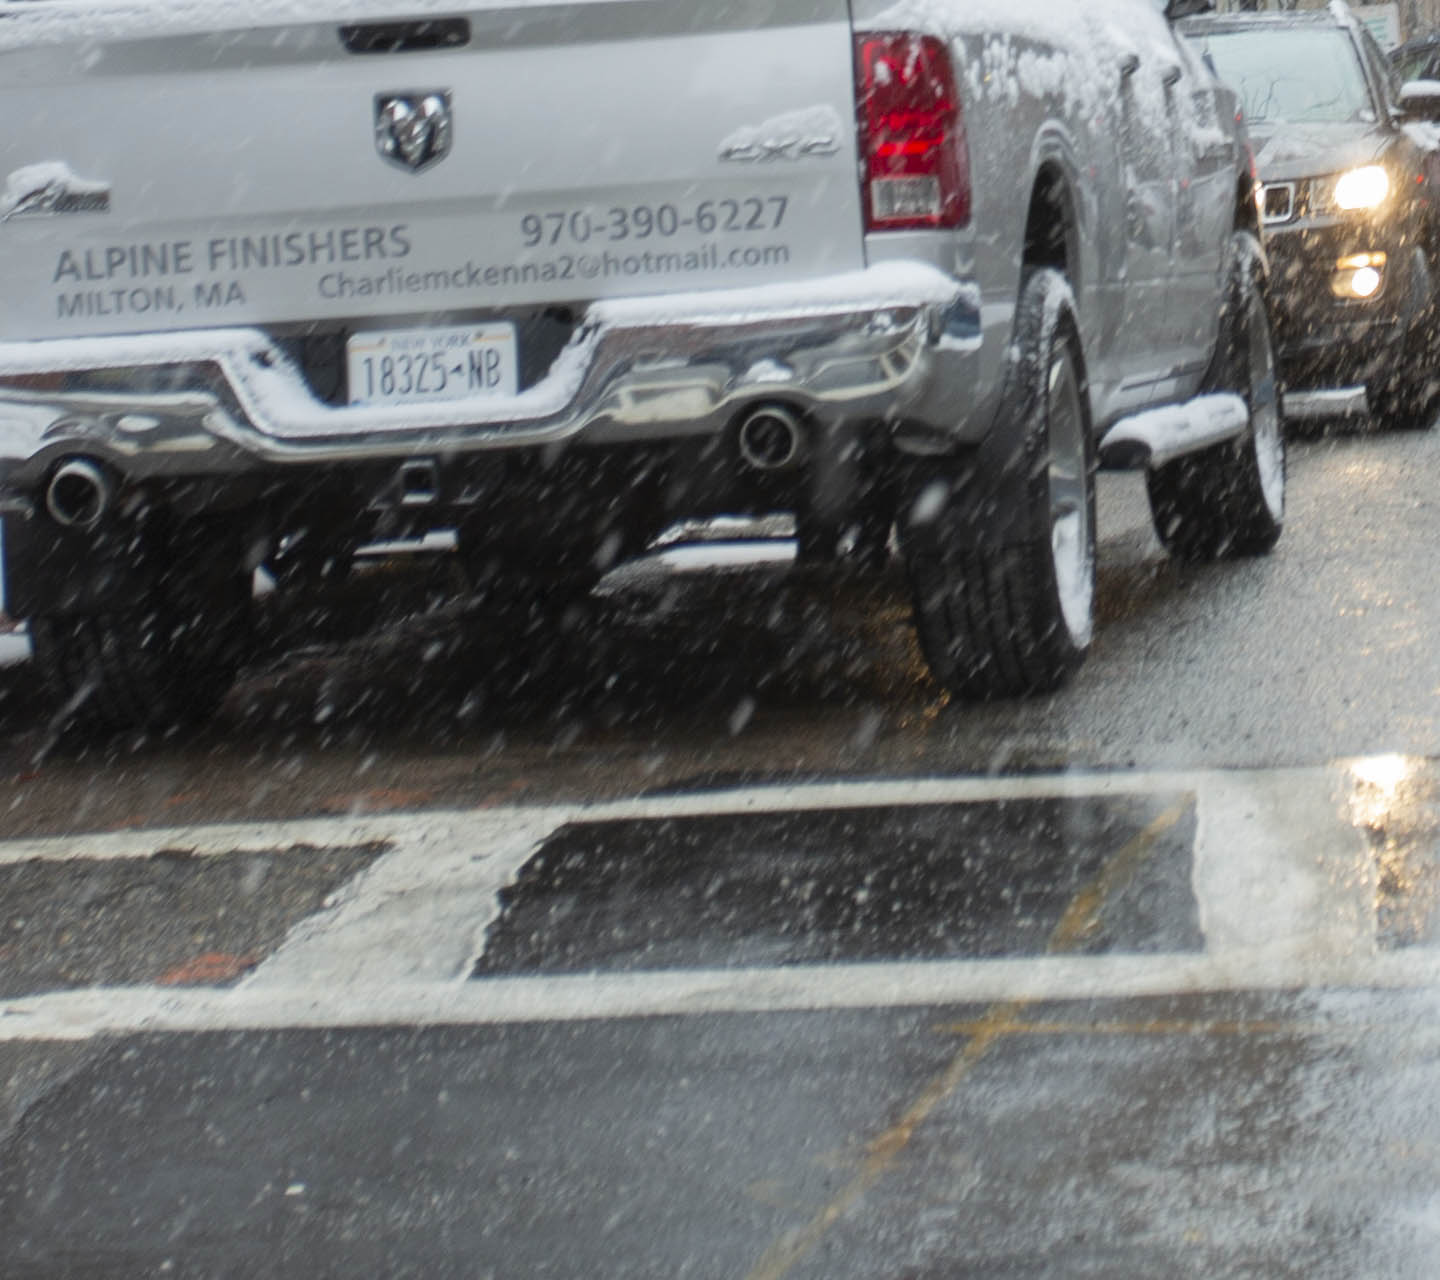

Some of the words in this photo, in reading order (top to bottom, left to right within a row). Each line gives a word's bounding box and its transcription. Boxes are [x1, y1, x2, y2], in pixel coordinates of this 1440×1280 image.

[521, 196, 790, 248] 970-390-6227
[53, 241, 193, 282] ALPINE
[208, 224, 412, 272] FINISHERS
[318, 243, 791, 300] Charliemckenna2@hotmail.com
[56, 287, 184, 318] MILTON,
[193, 280, 248, 308] MA
